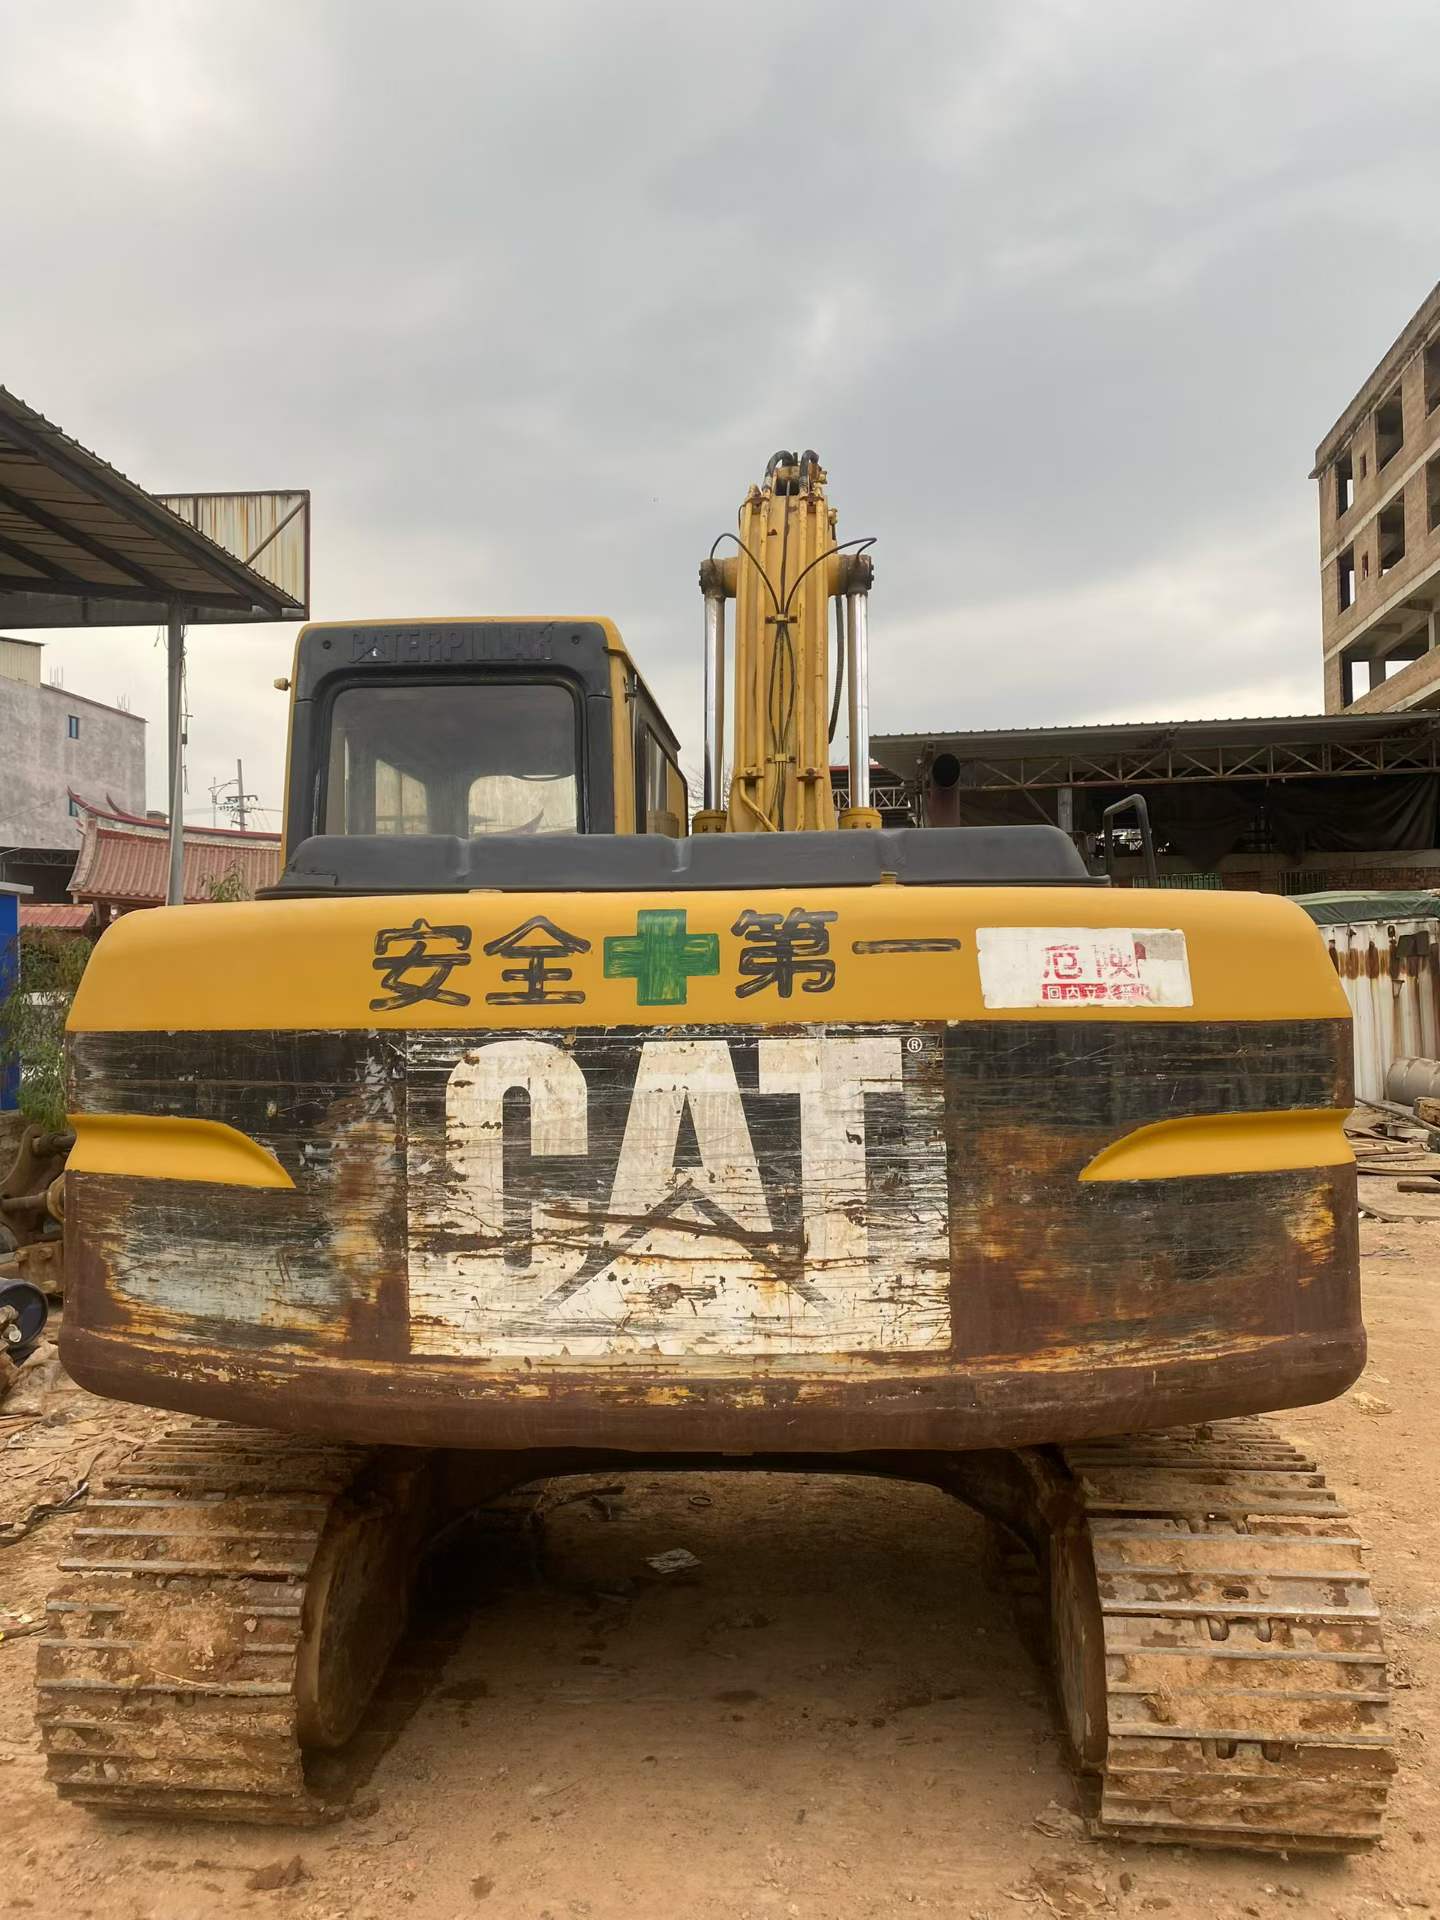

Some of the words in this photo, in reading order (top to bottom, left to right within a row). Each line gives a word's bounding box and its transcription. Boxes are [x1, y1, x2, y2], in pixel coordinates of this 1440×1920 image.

[352, 627, 552, 663] CATERPILLAR
[368, 917, 592, 1012] 安全
[730, 907, 962, 999] 第一
[446, 1038, 903, 1316] CAT
